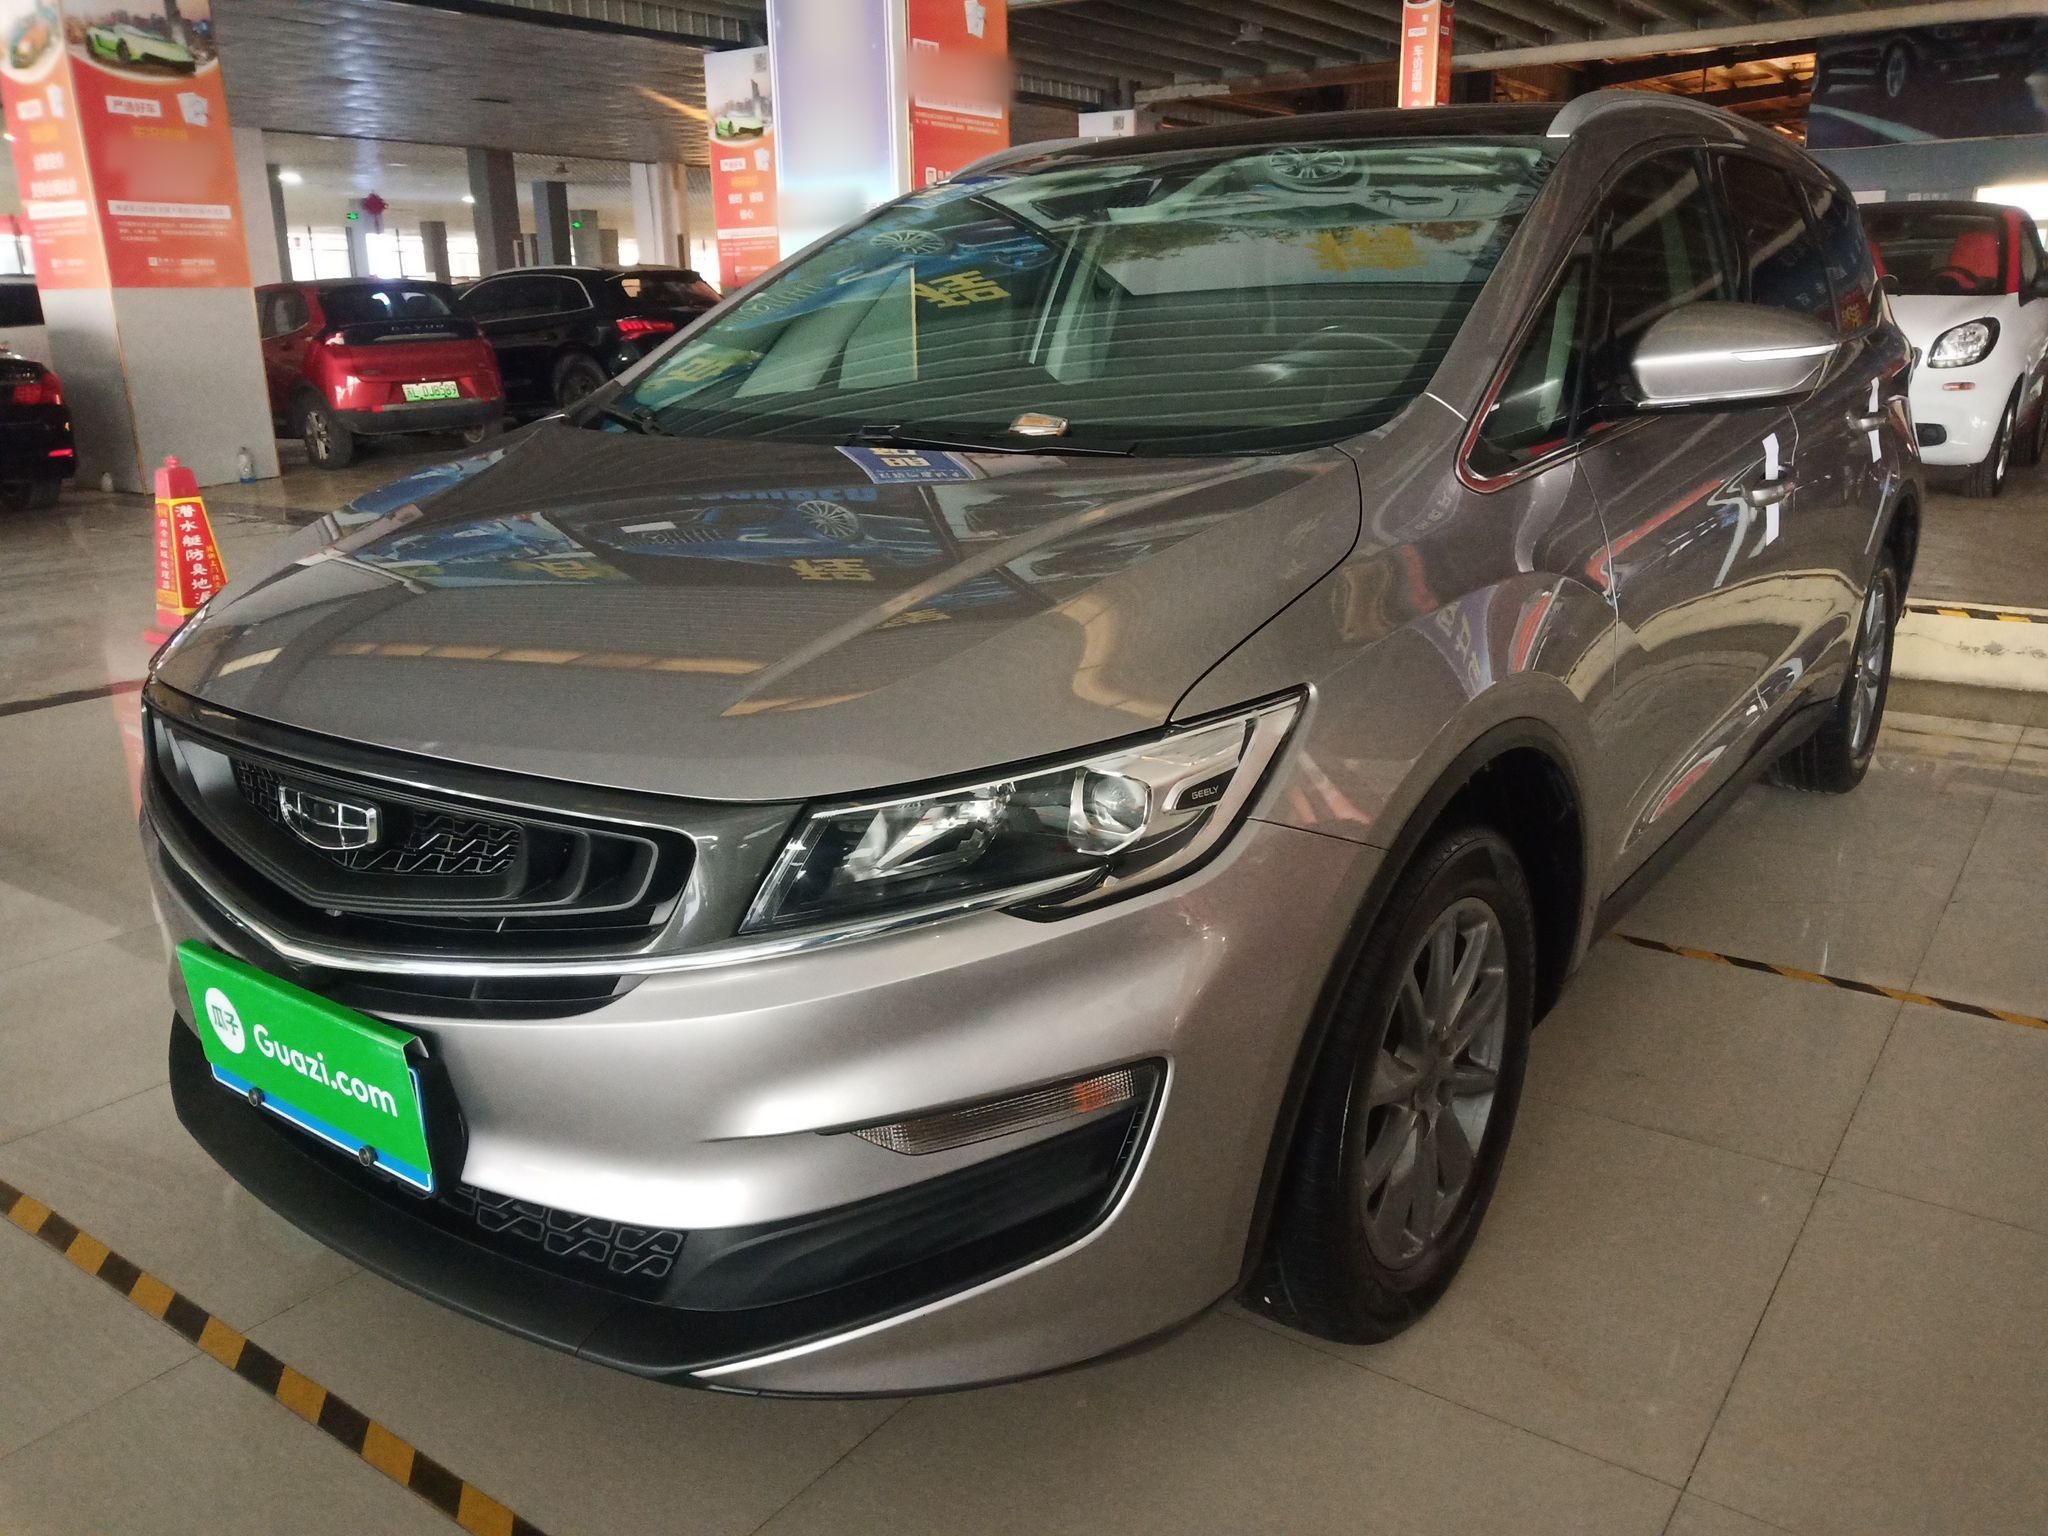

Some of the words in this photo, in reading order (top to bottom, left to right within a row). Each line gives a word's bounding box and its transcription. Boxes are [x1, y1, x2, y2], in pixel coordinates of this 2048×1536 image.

[1191, 786, 1219, 800] GEELY
[210, 1005, 239, 1036] 瓜子
[252, 1023, 399, 1119] Guazi.com
